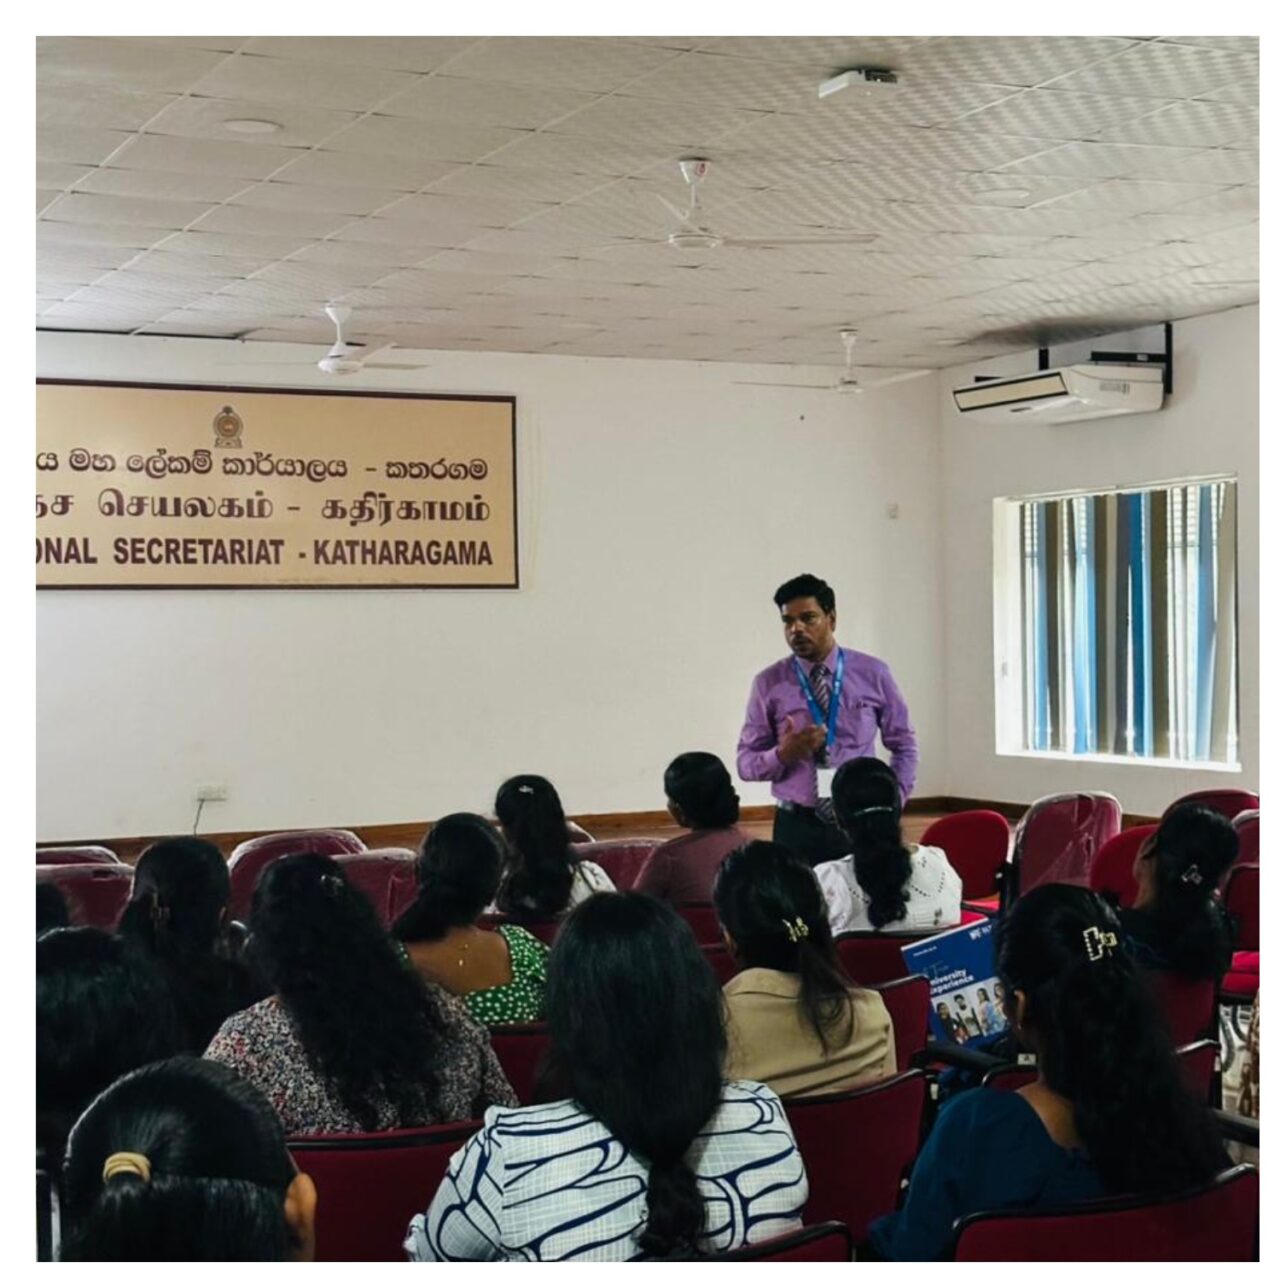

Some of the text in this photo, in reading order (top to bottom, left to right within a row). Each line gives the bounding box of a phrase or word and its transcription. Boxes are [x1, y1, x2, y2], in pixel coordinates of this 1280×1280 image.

[69, 448, 116, 472] මහ
[126, 448, 213, 479] ලේකම්
[222, 451, 348, 482] කාර්යාලය
[385, 457, 489, 481] කතරගම
[98, 488, 274, 519] செயலகம்
[321, 490, 491, 527] கதிர்காமம்
[113, 538, 285, 565] SECRETARIAT
[314, 539, 493, 566] KATHARAGAMA
